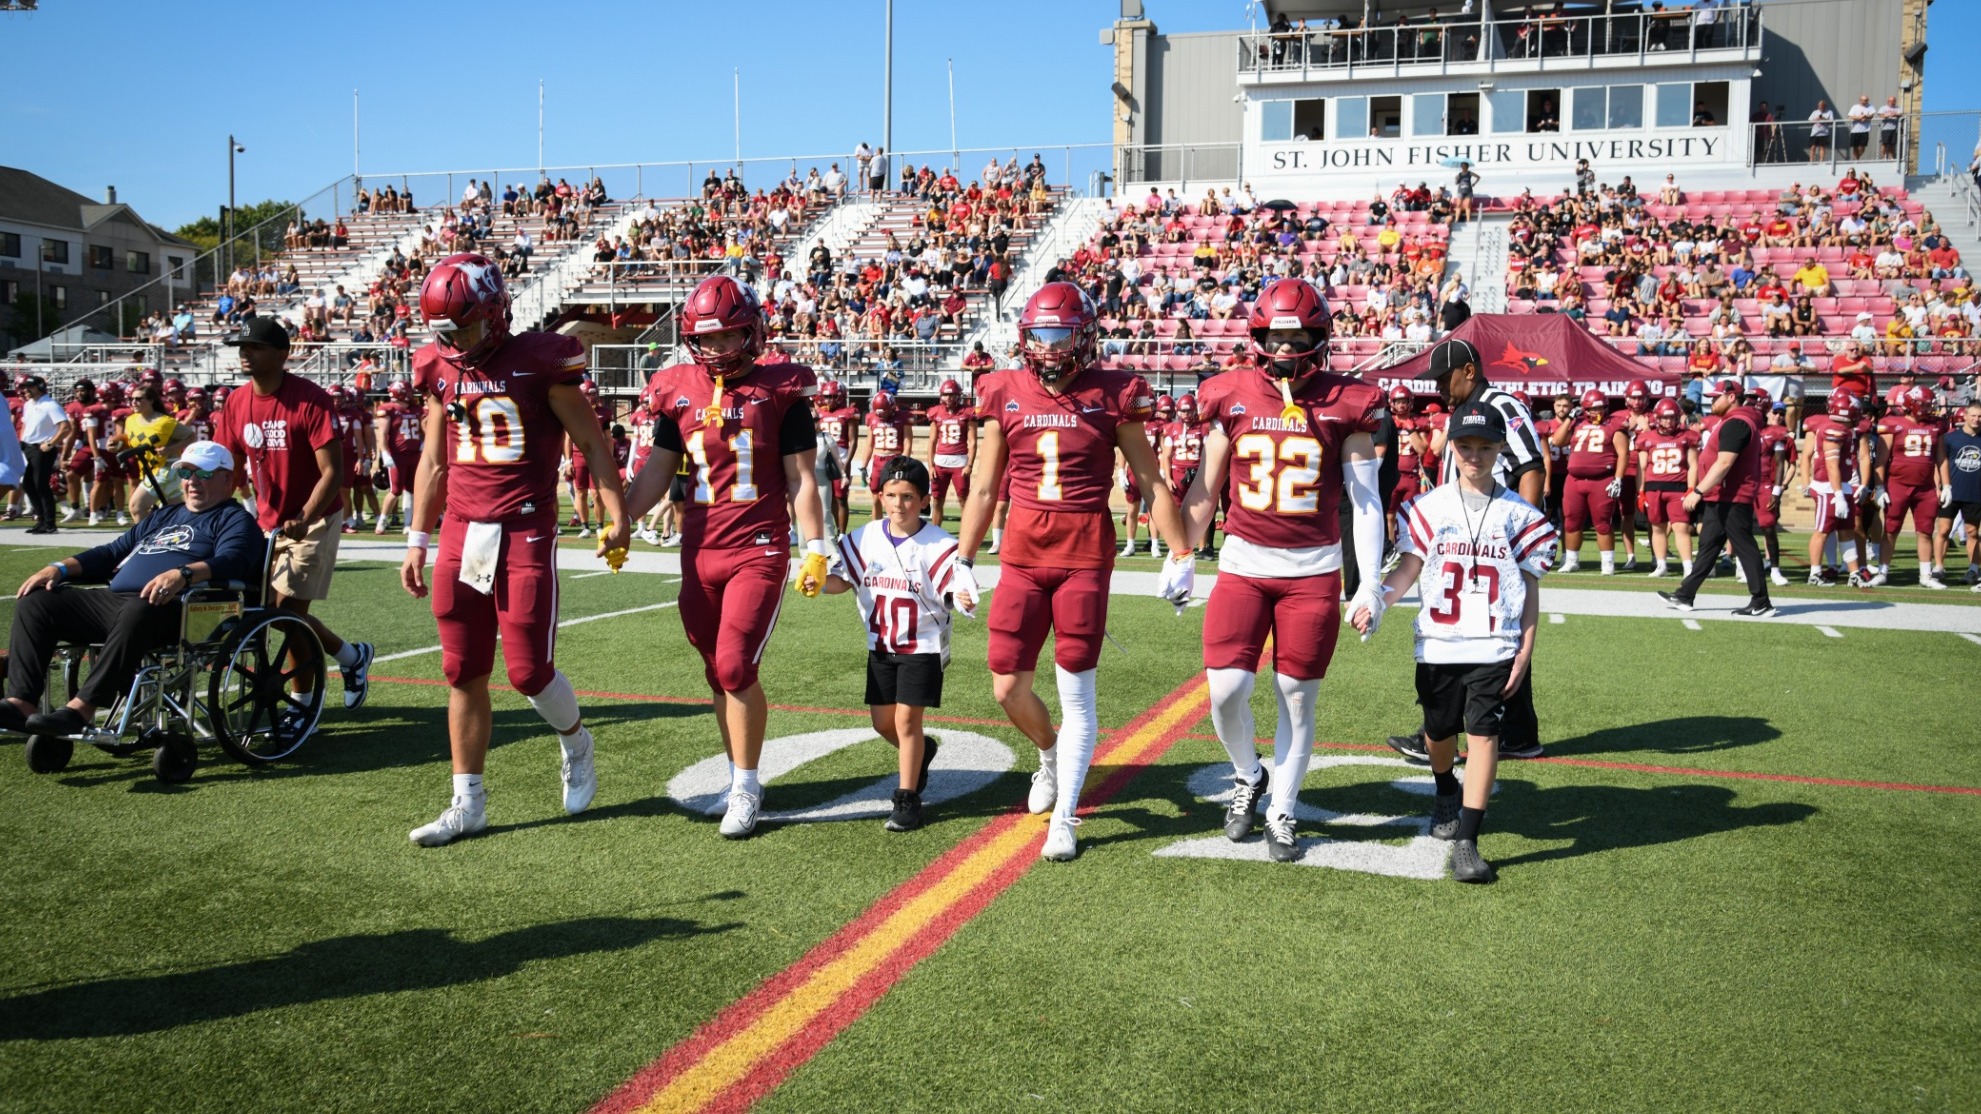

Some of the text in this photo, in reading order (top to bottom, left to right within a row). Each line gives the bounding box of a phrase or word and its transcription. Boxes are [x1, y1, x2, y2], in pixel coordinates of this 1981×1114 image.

[1273, 137, 1719, 169] ST. JOHN FISHER UNIVERSITY
[1572, 380, 1664, 396] TRAING
[262, 420, 287, 430] CAMP
[695, 407, 744, 421] CANALS
[1023, 414, 1077, 428] CARDINALS
[1252, 416, 1308, 433] CARDINALS
[264, 430, 286, 439] GOOD
[400, 418, 420, 439] 42
[456, 396, 525, 463] 10
[872, 427, 898, 449] 28
[1574, 429, 1605, 453] 72
[1904, 434, 1932, 456] 91
[686, 429, 758, 504] 11
[1037, 430, 1063, 501] 1
[1651, 448, 1682, 474] 62
[1235, 433, 1323, 514] 32
[1436, 542, 1507, 560] CARDINALS
[864, 576, 921, 594] CARDINALS
[1429, 561, 1500, 633] 32
[869, 594, 918, 654] 40
